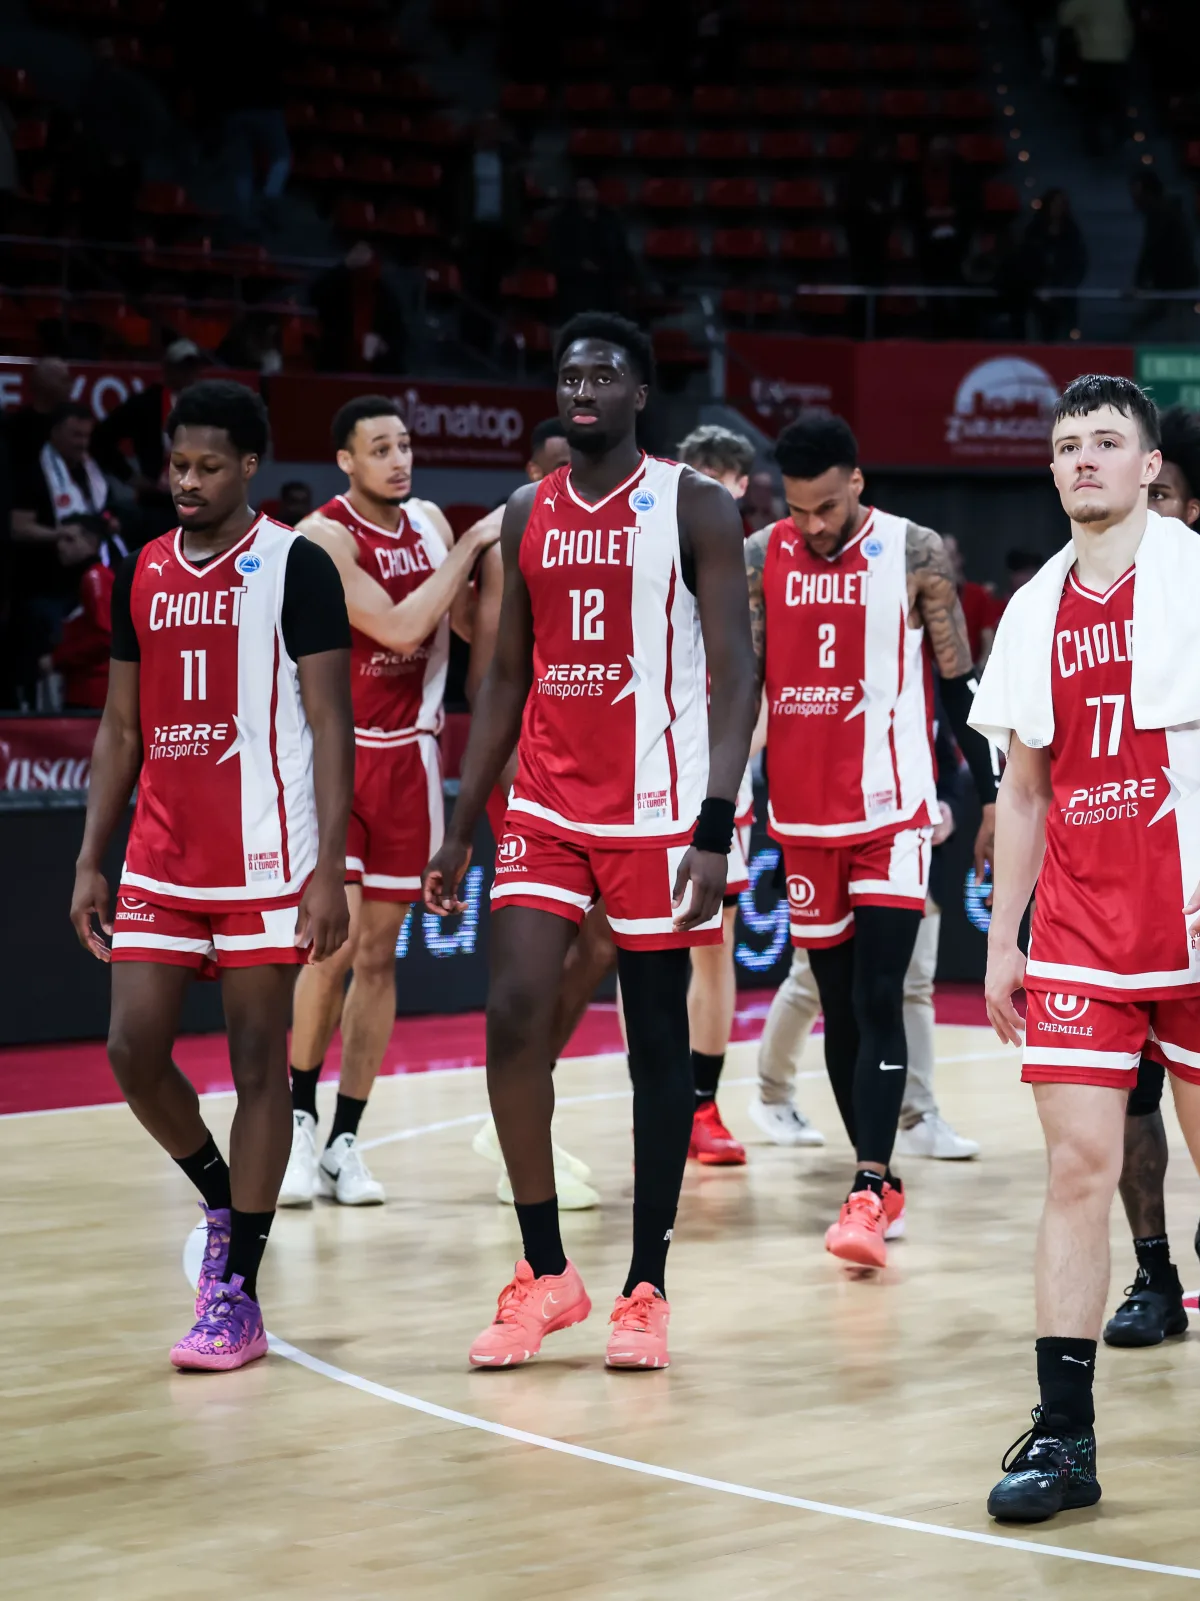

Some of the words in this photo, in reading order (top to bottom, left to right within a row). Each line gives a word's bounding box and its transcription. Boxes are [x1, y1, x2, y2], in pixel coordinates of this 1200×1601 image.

[542, 526, 641, 569] CHOLET
[149, 586, 248, 632] CHOLET
[785, 570, 873, 607] CHOLET
[569, 588, 605, 641] 12
[818, 623, 836, 668] 2
[1056, 619, 1134, 679] CHOLE
[180, 649, 207, 701] 11
[537, 678, 604, 701] Transports
[1085, 694, 1125, 758] 77
[1037, 1021, 1093, 1037] CHEMILLÉ
